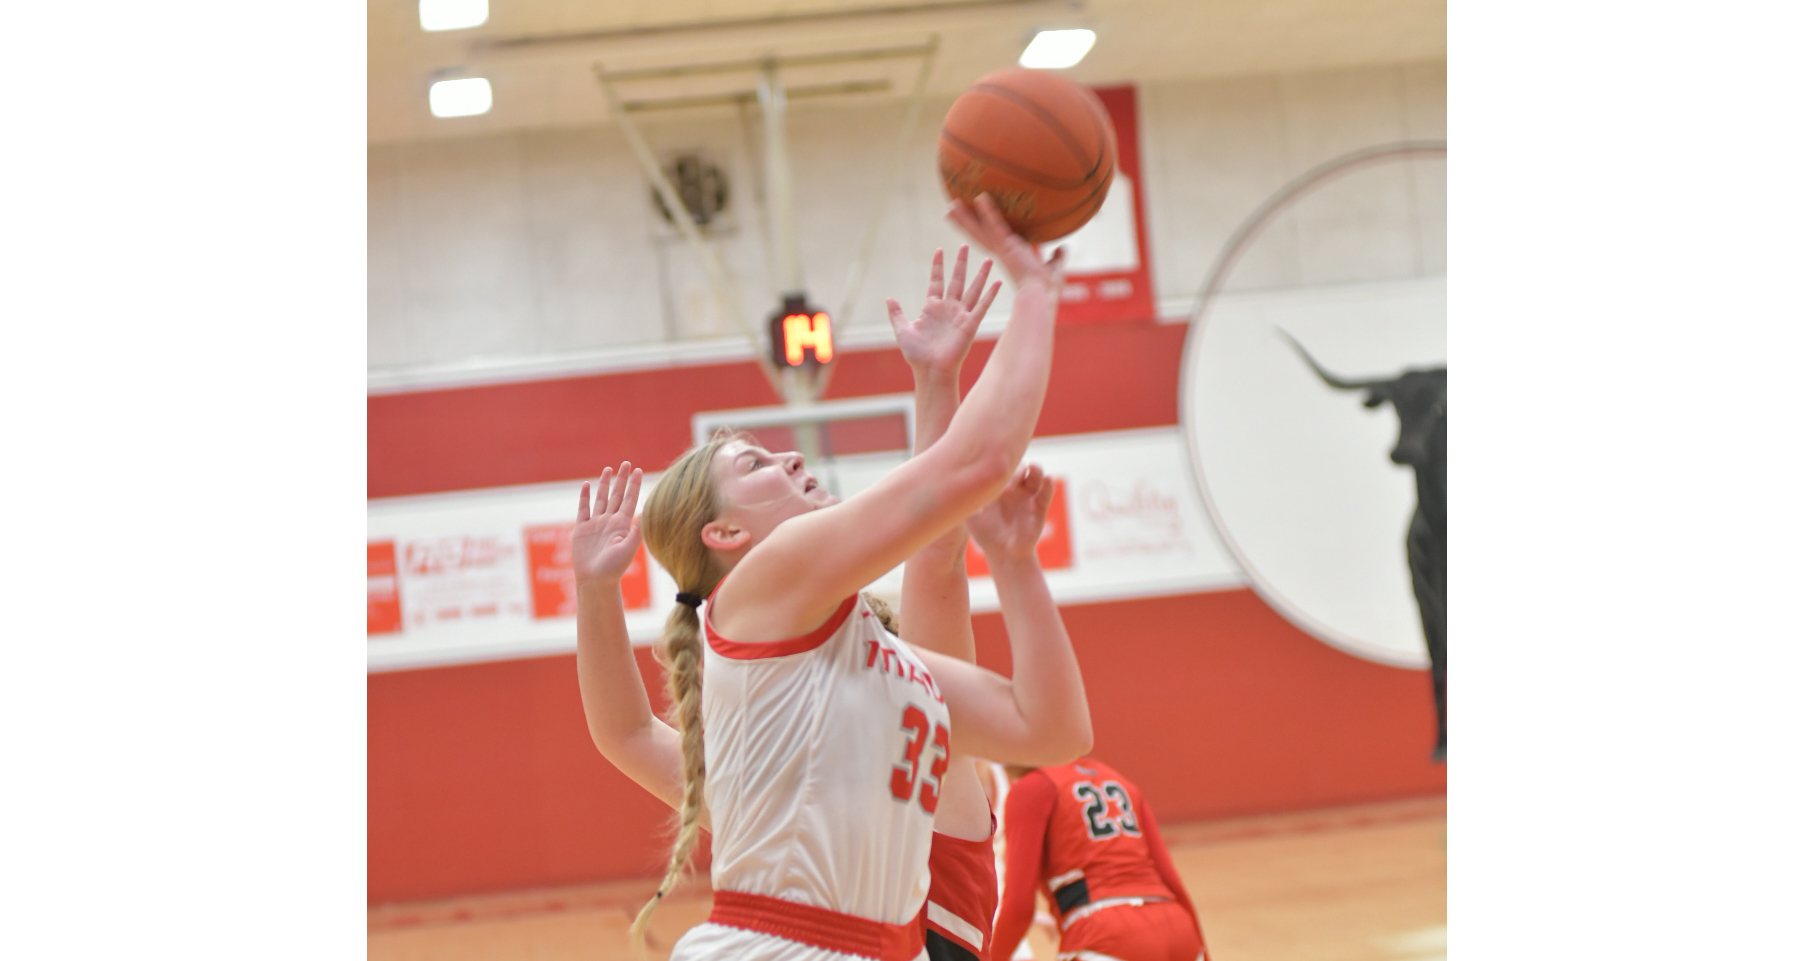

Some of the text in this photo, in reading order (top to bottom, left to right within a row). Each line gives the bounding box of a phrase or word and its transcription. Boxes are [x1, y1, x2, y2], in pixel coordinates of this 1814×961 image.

[783, 312, 833, 366] 14
[888, 701, 949, 816] 33
[1072, 781, 1142, 841] 23
